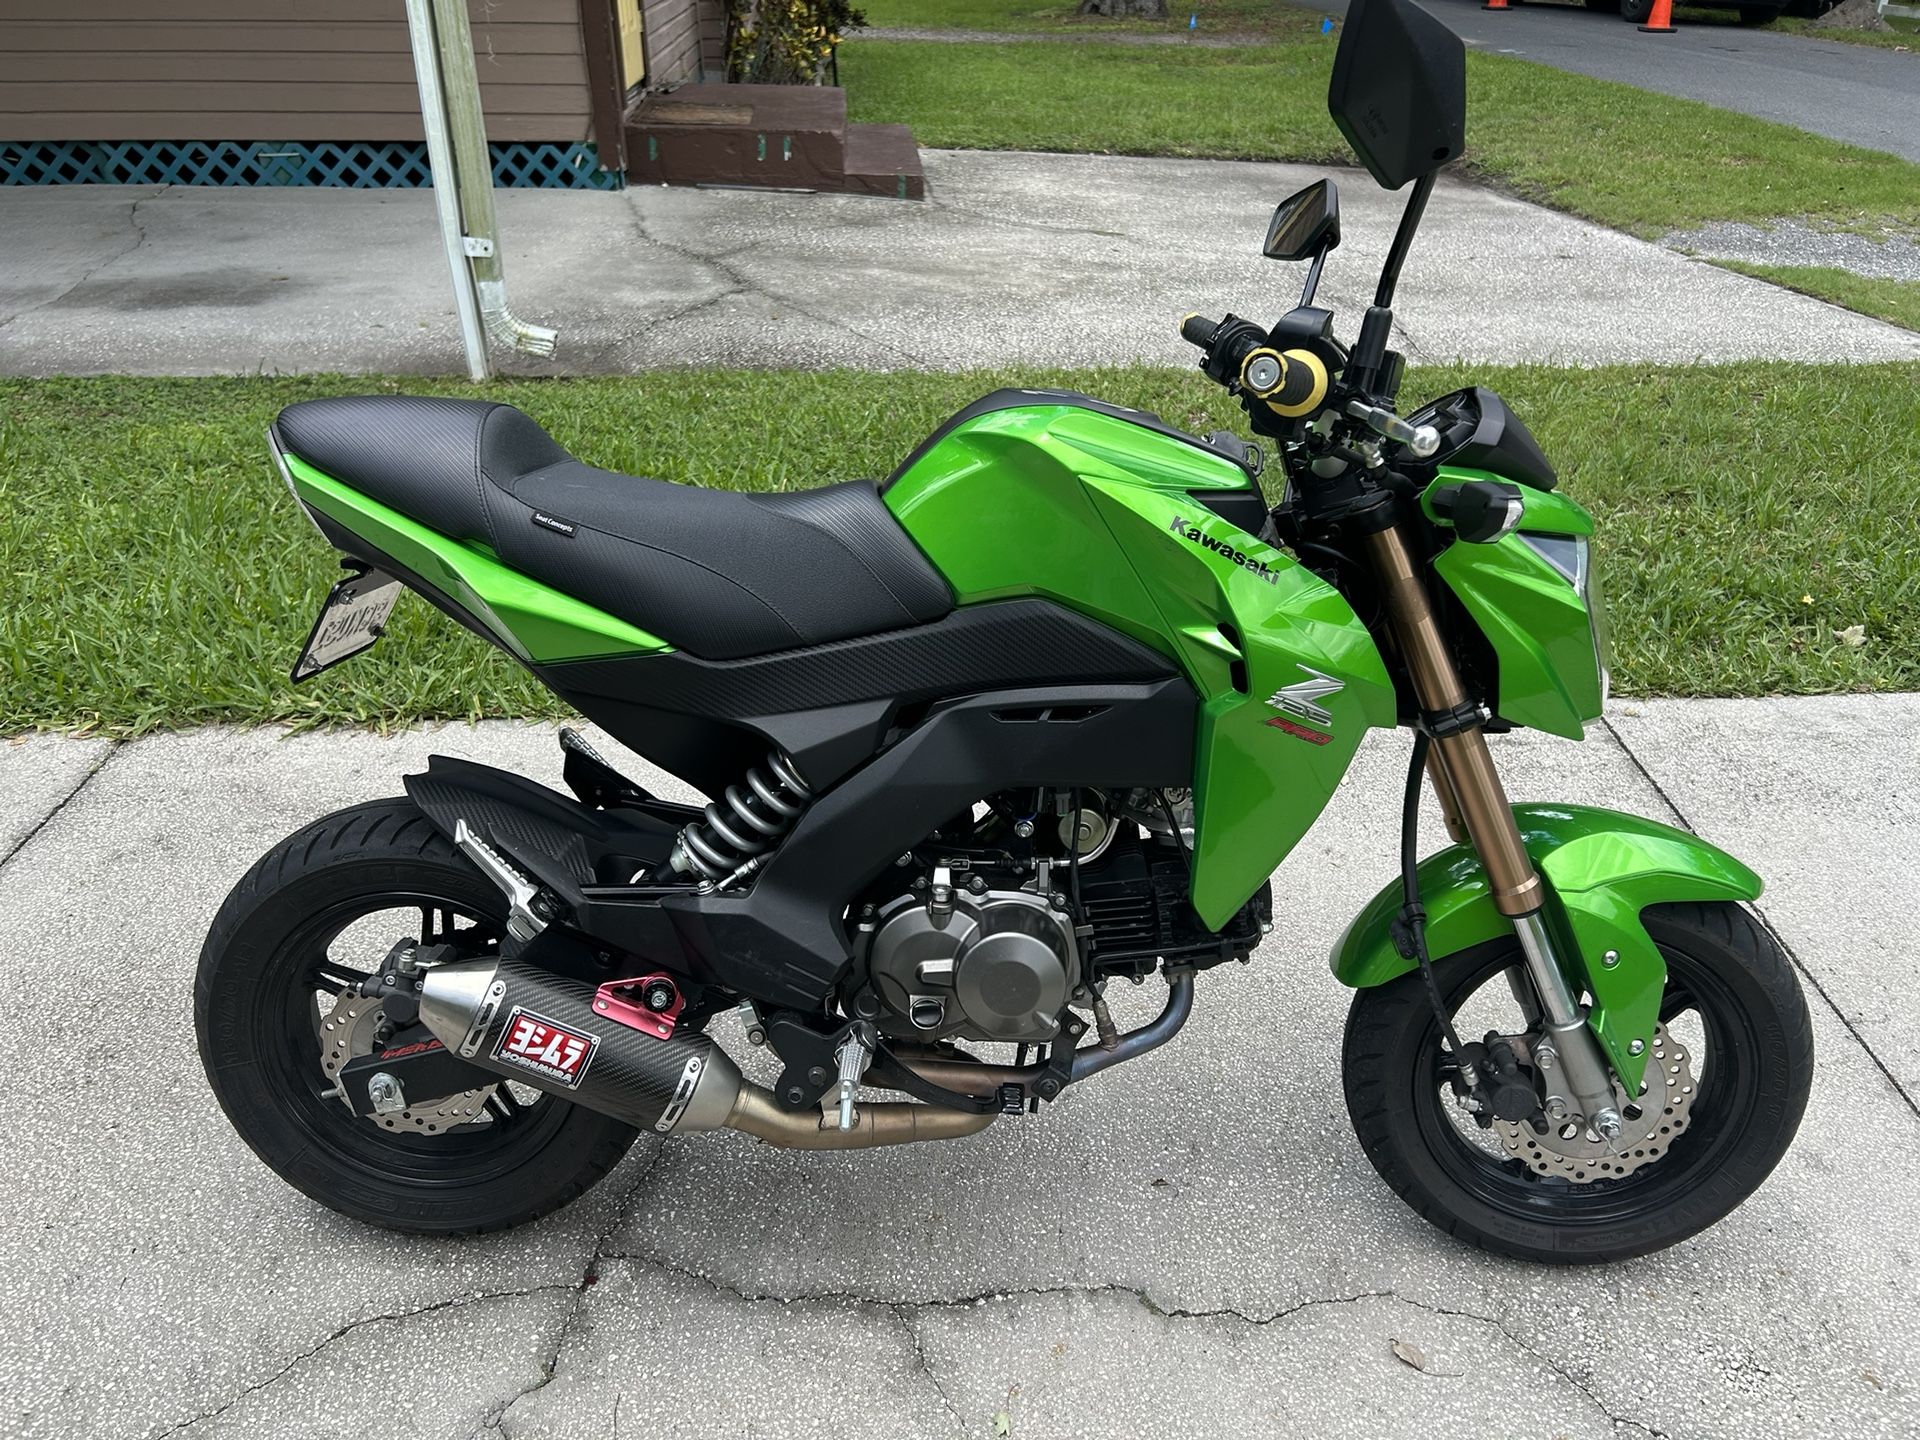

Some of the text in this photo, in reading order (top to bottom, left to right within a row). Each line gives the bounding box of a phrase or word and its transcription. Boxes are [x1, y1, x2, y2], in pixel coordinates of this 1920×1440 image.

[547, 518, 573, 532] Concepts
[1169, 515, 1280, 586] Kawasaki
[1276, 664, 1345, 716] Z
[1266, 716, 1334, 746] PRO
[500, 1049, 573, 1082] YOSHIMURA
[508, 1019, 586, 1070] ヨシムラ
